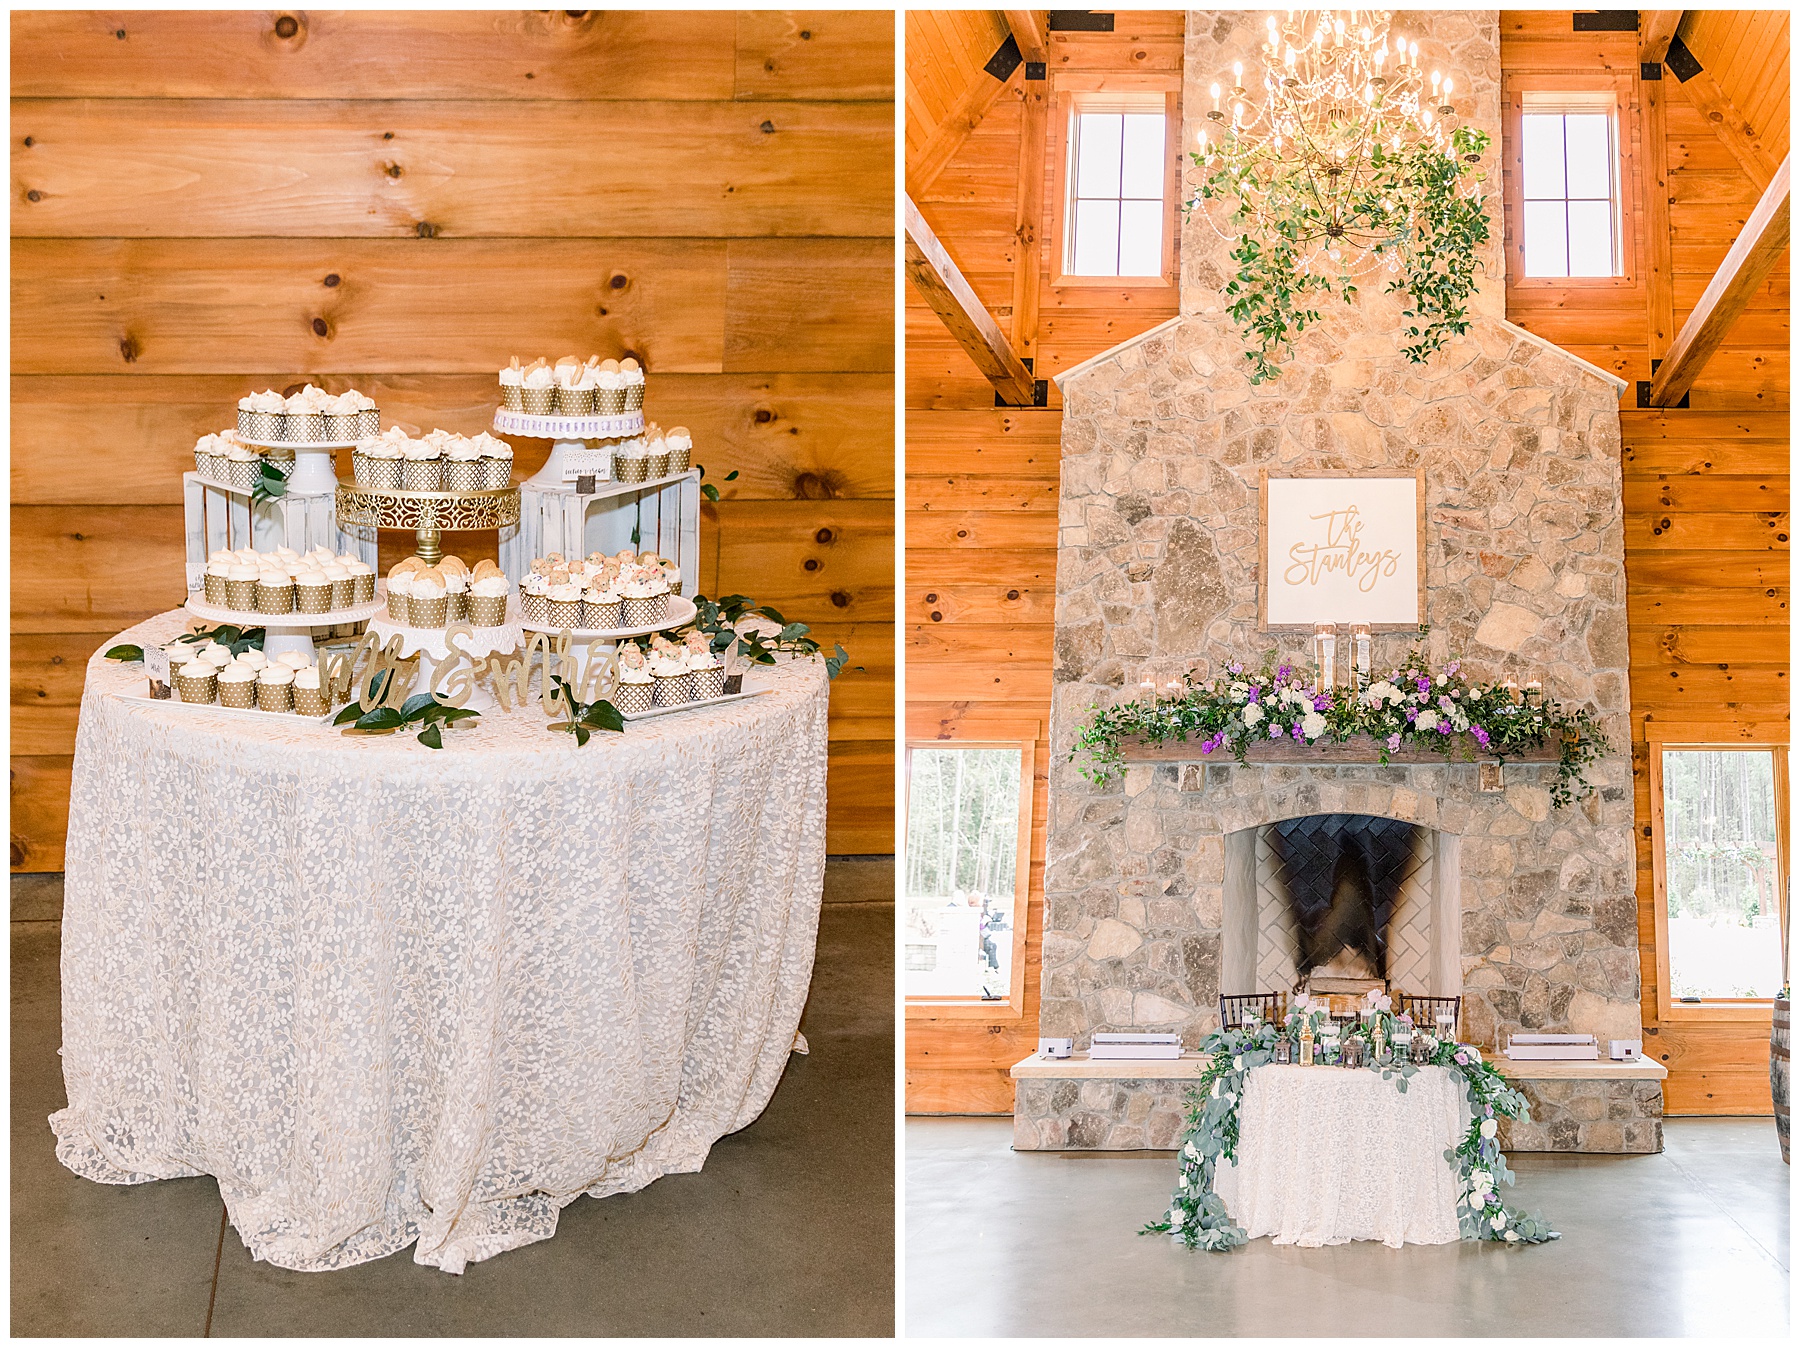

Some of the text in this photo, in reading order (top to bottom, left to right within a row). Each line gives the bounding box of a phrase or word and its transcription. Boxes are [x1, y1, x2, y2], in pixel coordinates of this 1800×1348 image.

[1309, 504, 1365, 547] The
[1283, 537, 1402, 593] Stanleys
[430, 624, 487, 707] &
